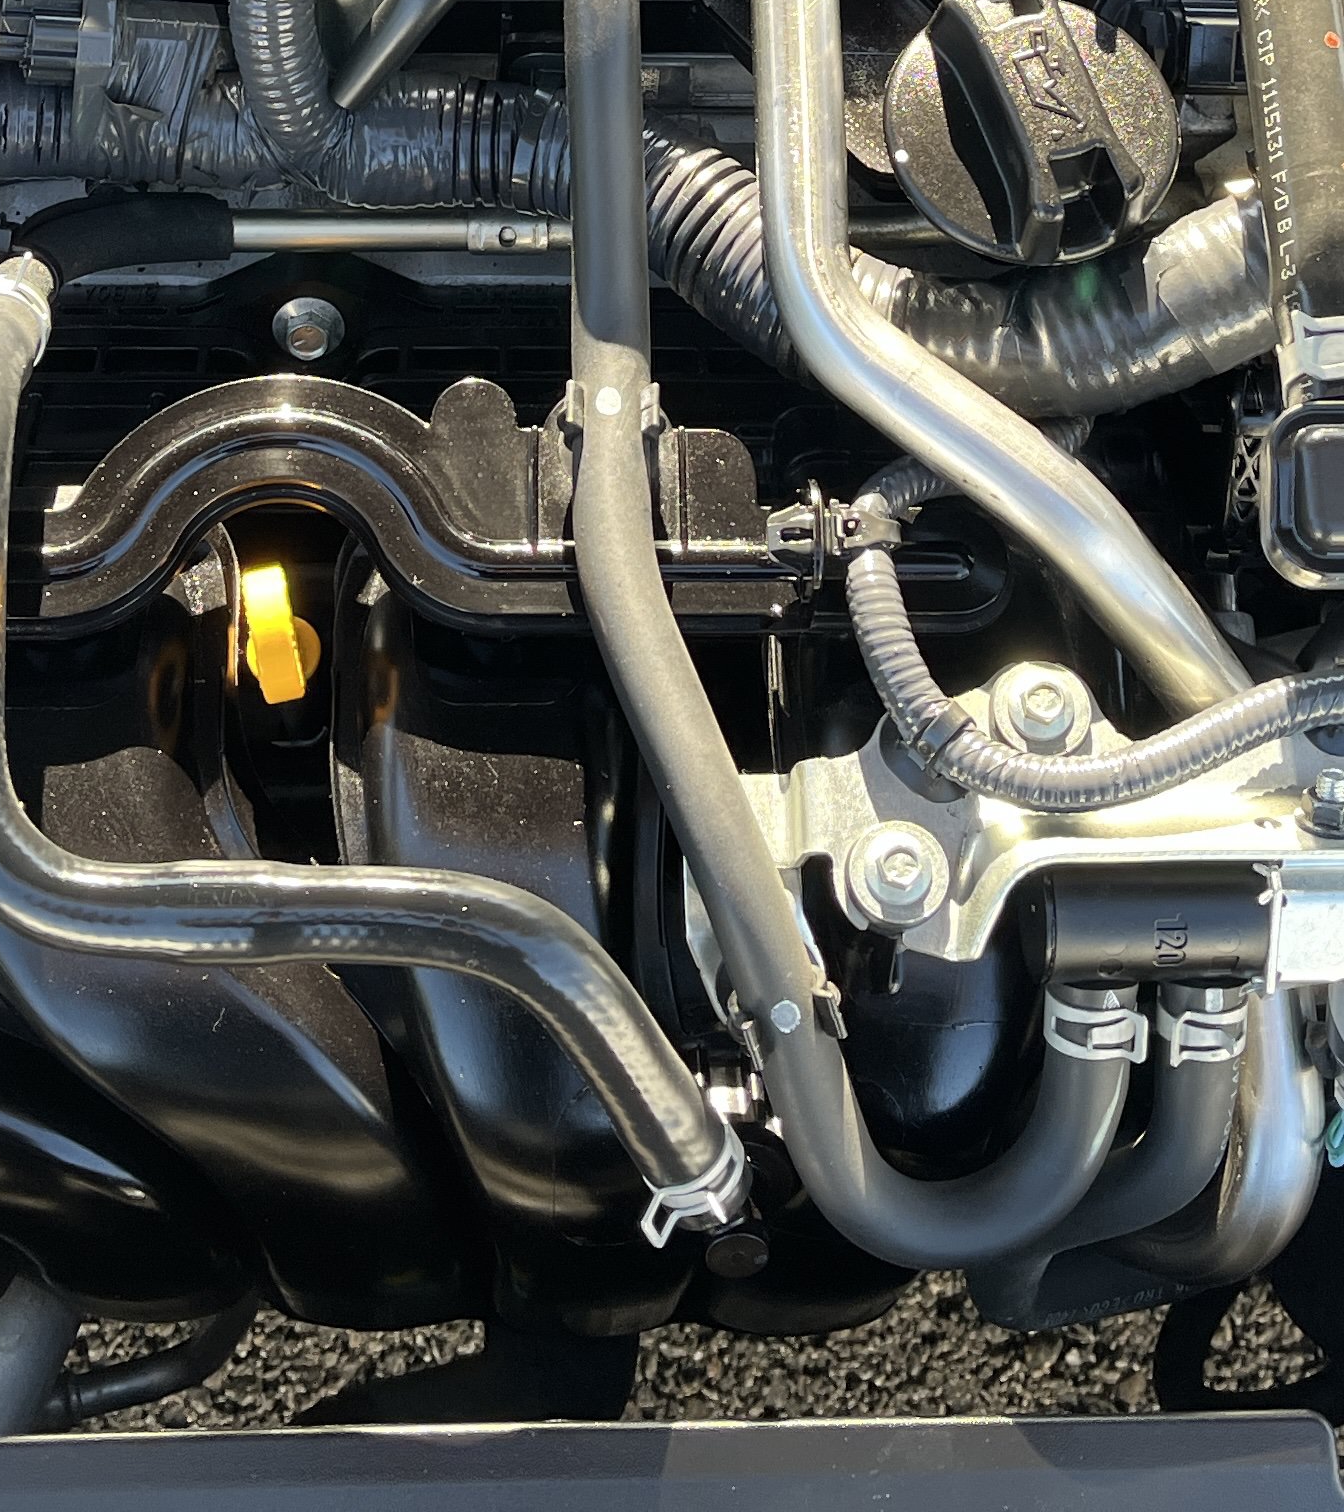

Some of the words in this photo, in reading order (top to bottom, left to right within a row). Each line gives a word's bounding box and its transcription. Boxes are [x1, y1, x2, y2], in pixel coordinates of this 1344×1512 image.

[1256, 29, 1276, 67] CIP
[1260, 77, 1285, 164] 1115131
[1277, 215, 1293, 235] B
[1279, 241, 1297, 282] L-3
[1153, 912, 1186, 969] 120
